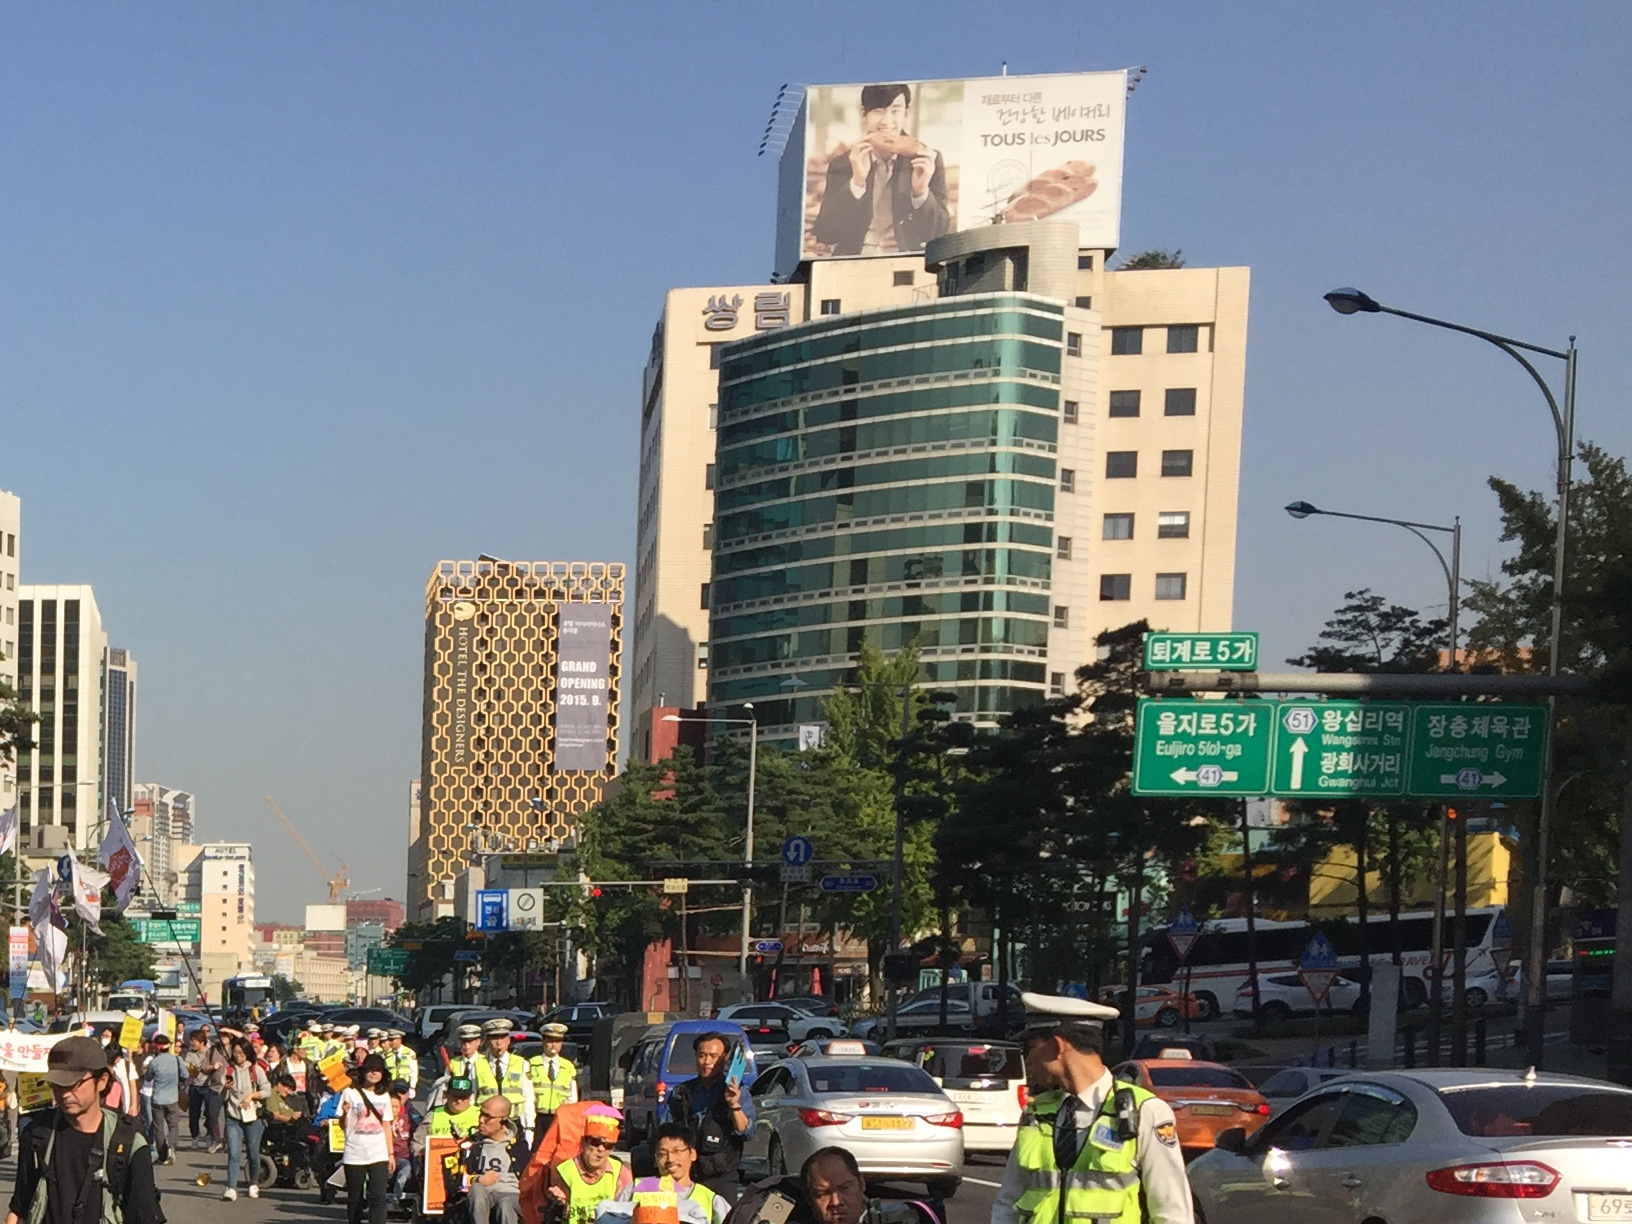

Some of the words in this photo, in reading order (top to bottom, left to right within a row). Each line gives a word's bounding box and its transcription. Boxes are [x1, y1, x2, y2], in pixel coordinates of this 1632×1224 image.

[997, 105, 1046, 126] 건강한
[1052, 104, 1110, 122] 베이커리
[981, 132, 1026, 147] TOUS
[1029, 131, 1051, 145] les
[1051, 128, 1106, 147] JOURS
[702, 292, 792, 332] 쌍림
[457, 627, 469, 667] HOTEL
[561, 660, 597, 673] GRAND
[456, 670, 468, 694] THE
[560, 678, 606, 690] OPENING
[454, 698, 466, 763] DESIGNERS
[1156, 711, 1257, 737] 을지로5가
[1292, 712, 1310, 728] 51
[1321, 709, 1404, 733] 왕십리역
[1427, 714, 1532, 740] 장충체육관
[1156, 740, 1196, 758] Euljiro
[1494, 744, 1524, 761] Gym
[1320, 752, 1401, 774] 광희사거리
[1201, 769, 1218, 783] 41
[1460, 770, 1478, 786] 41
